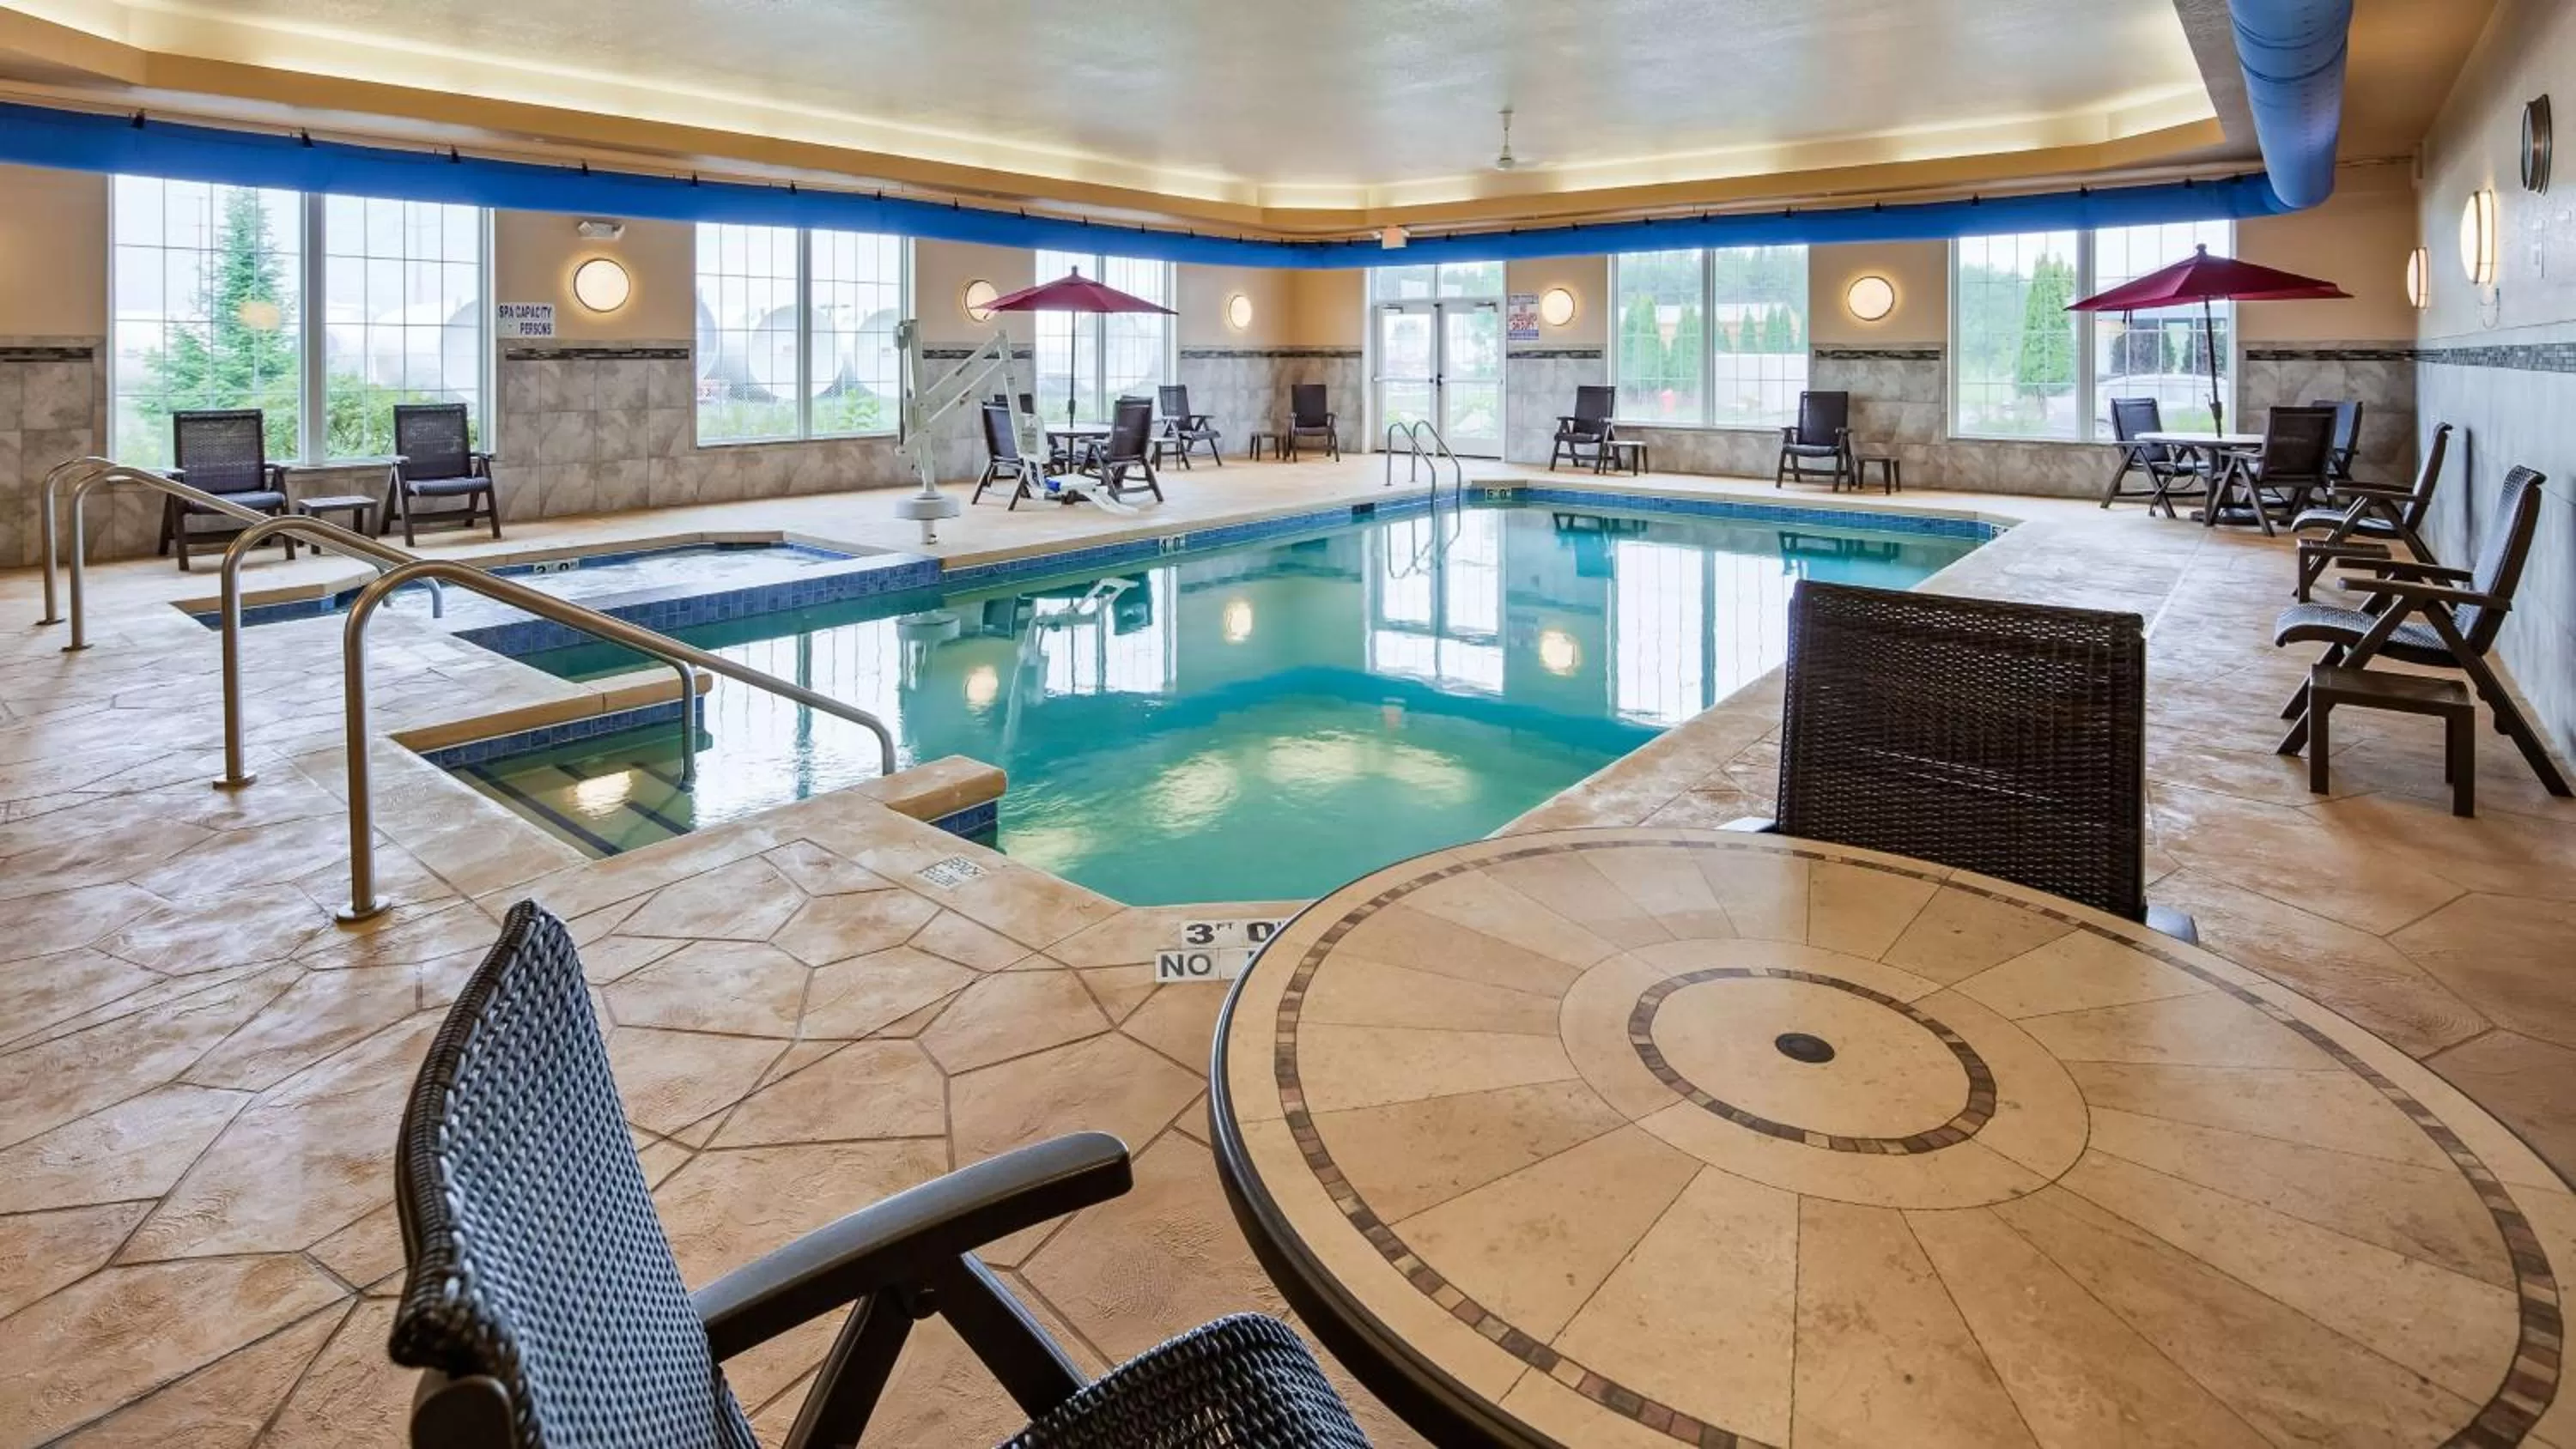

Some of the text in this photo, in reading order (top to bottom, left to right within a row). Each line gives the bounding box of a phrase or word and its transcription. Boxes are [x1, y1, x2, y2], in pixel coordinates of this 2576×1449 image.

[499, 305, 551, 318] SPA CAPACITY
[519, 322, 551, 335] PERSONS
[1161, 954, 1212, 977] NO
